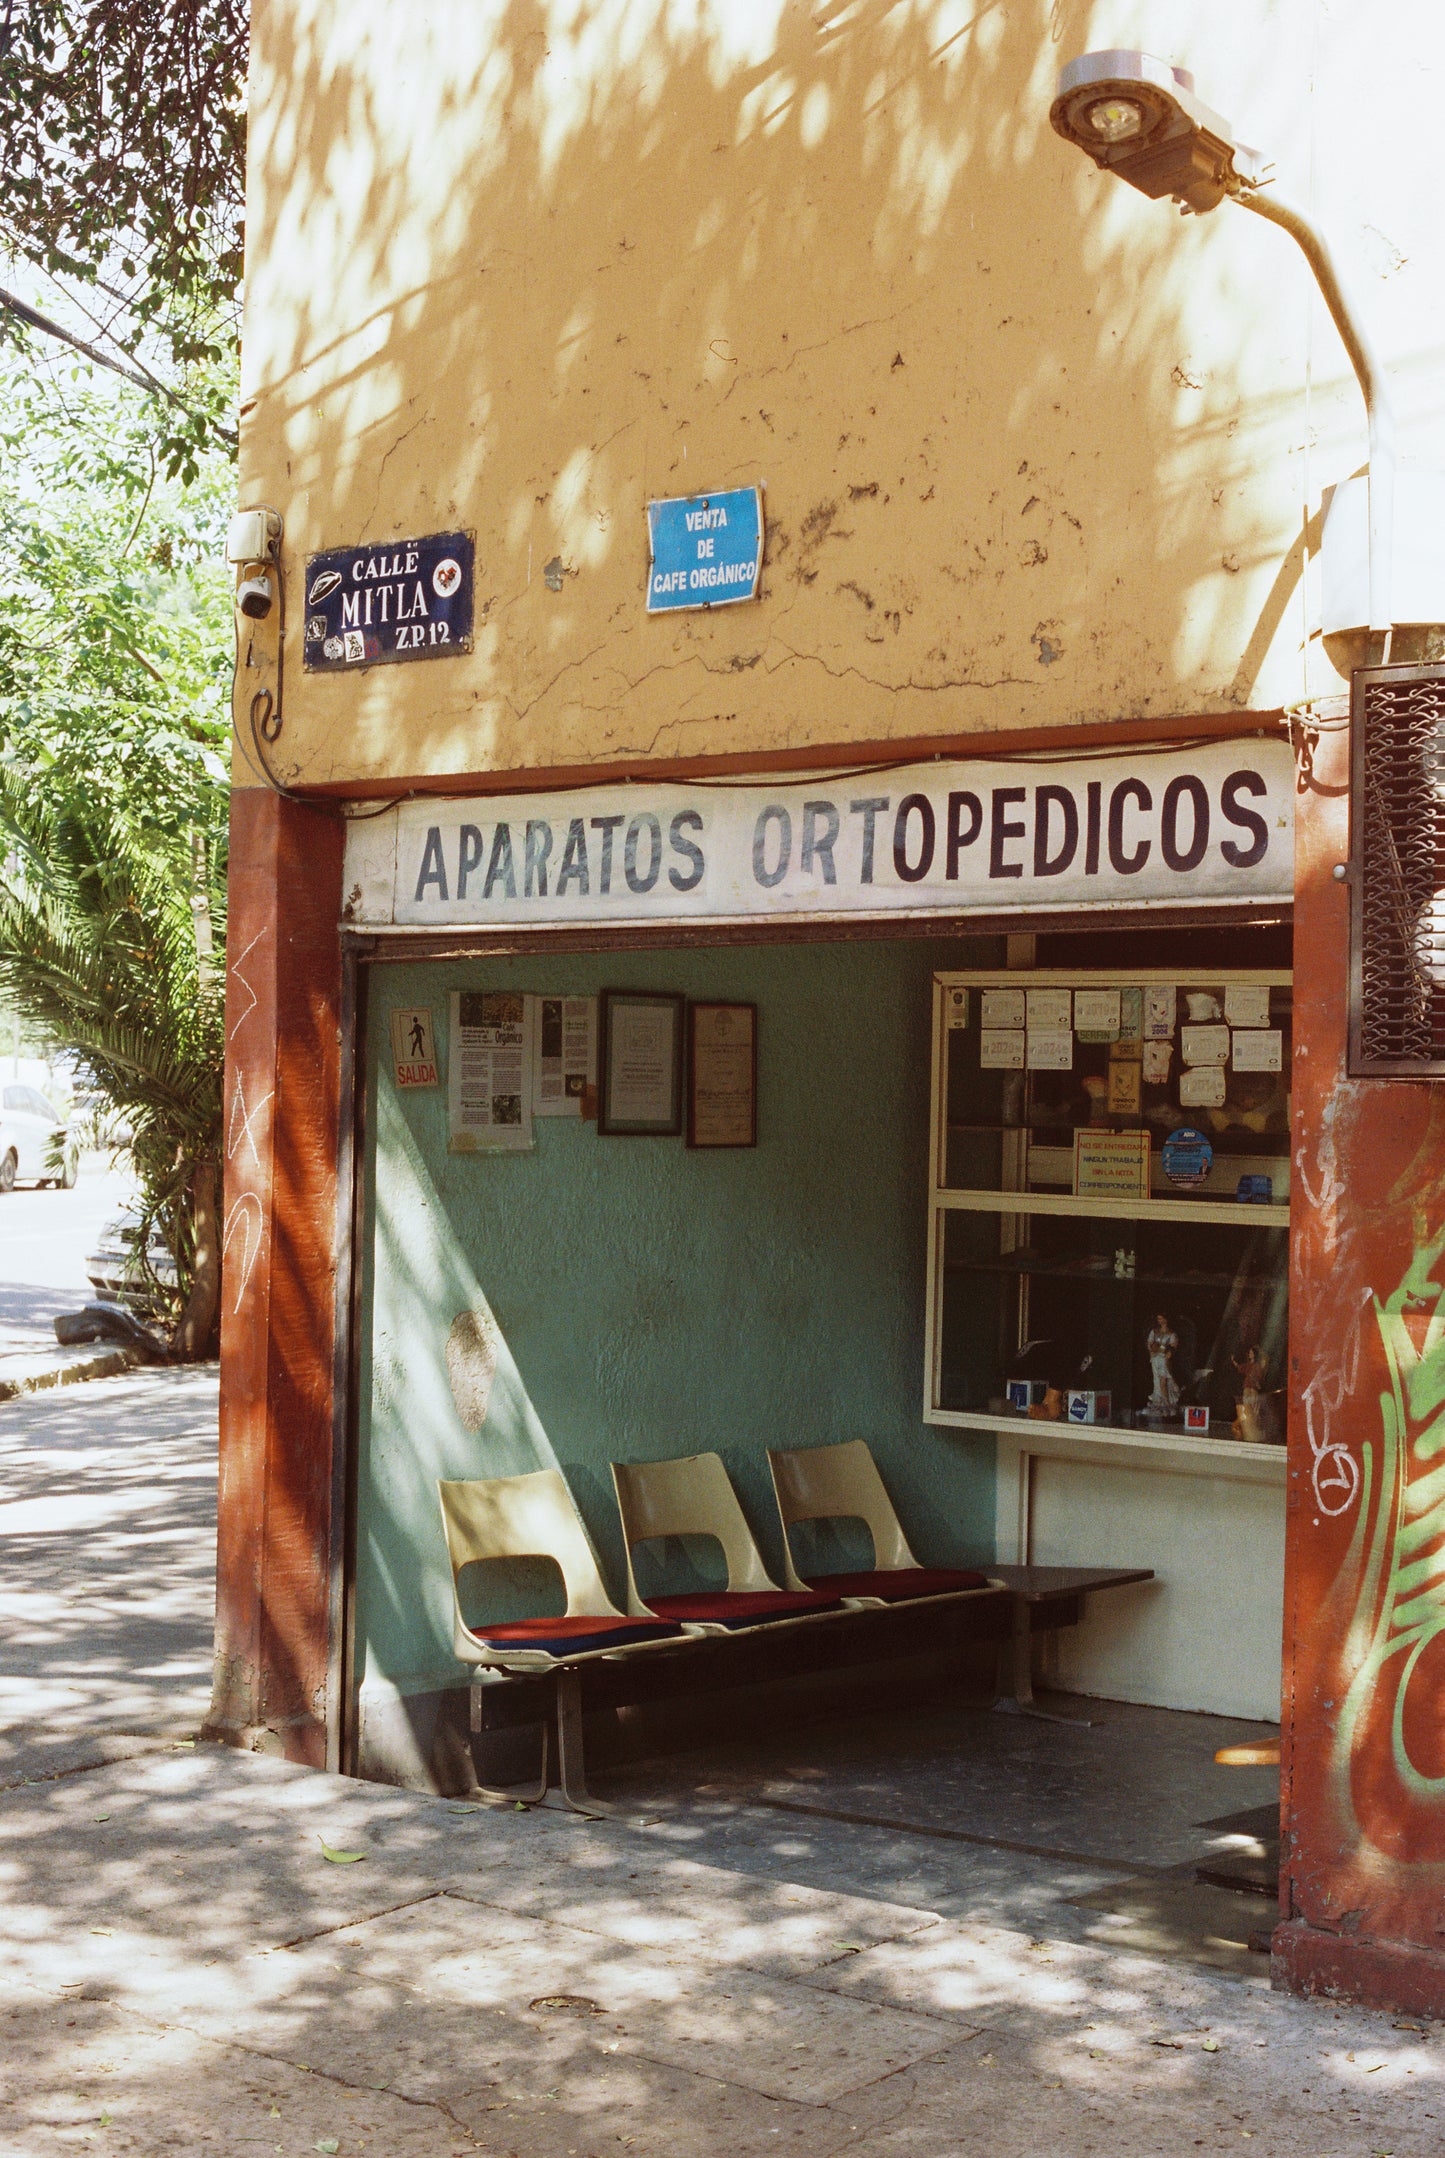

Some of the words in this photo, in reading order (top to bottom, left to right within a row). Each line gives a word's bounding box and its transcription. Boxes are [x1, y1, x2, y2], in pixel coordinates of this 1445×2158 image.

[685, 508, 728, 532] VENTA
[697, 538, 714, 559] DE
[352, 551, 419, 582] CALLE
[653, 570, 687, 593] CAFE
[689, 561, 756, 590] ORGÁNICO
[341, 580, 429, 629] MITLA
[414, 808, 706, 903] APARATOS
[751, 767, 1269, 889] ORTOPEDICOS
[397, 1064, 437, 1085] SALIDA
[1108, 1156, 1144, 1164] TRABAJO
